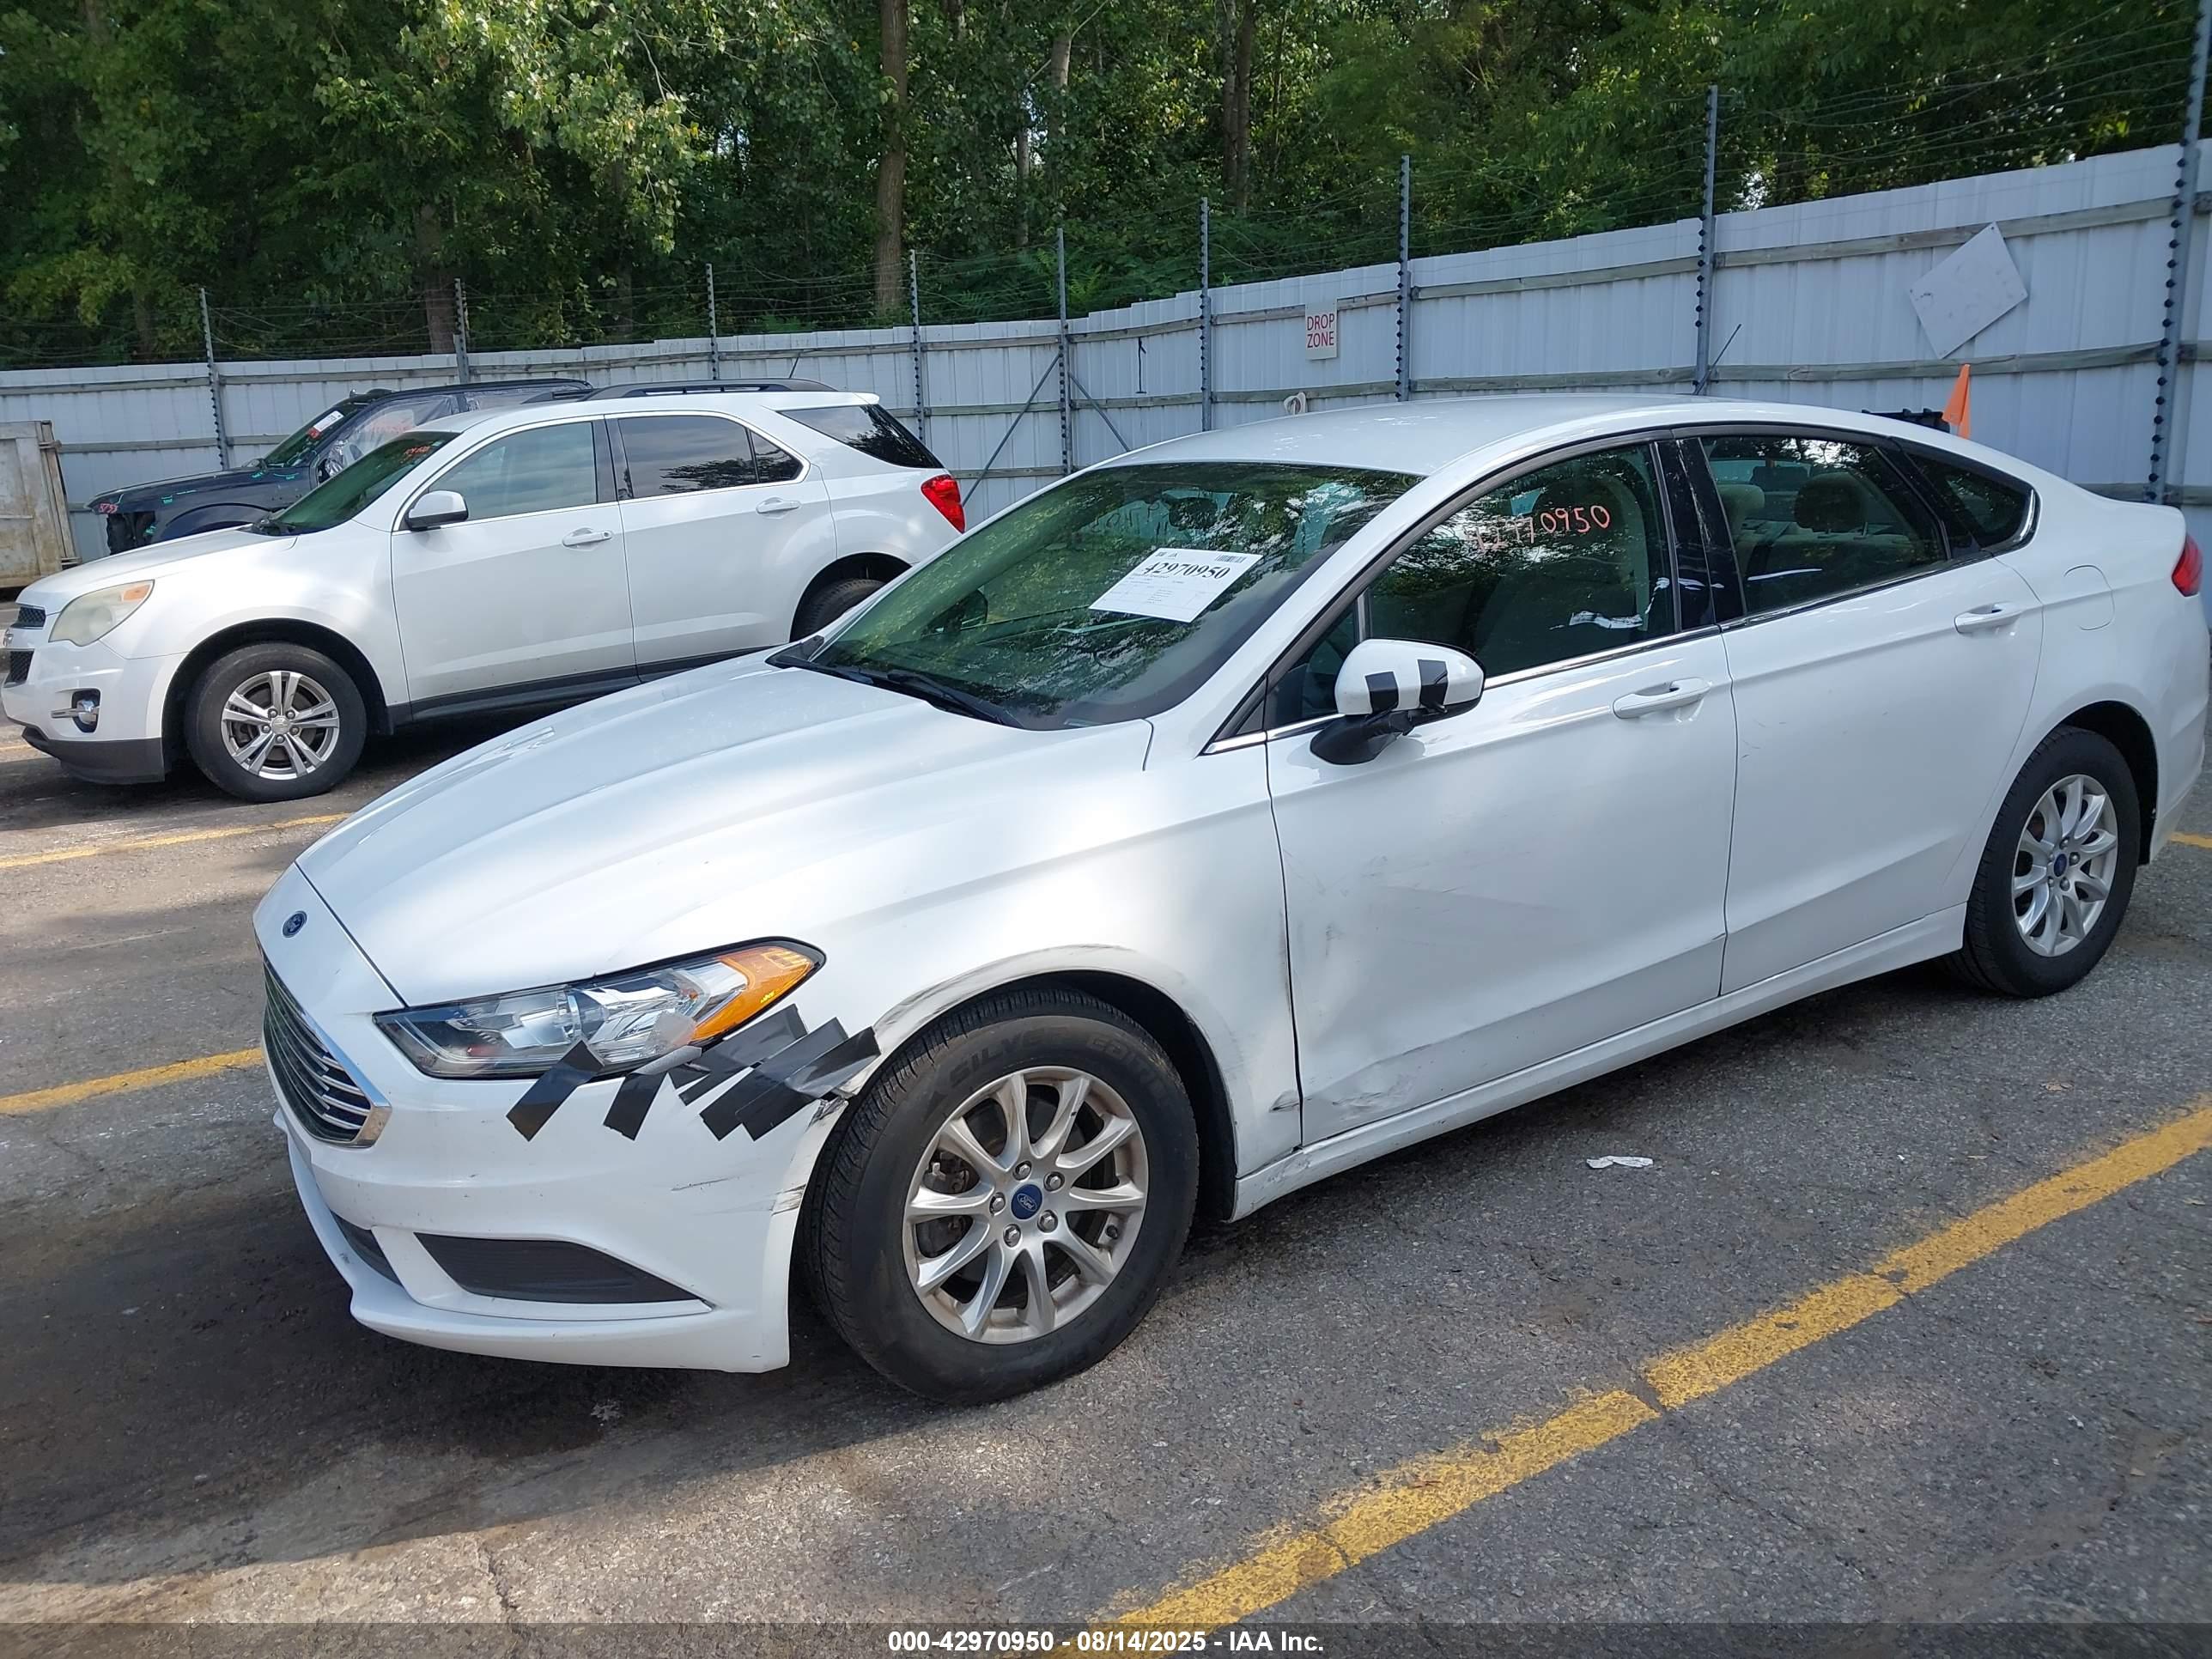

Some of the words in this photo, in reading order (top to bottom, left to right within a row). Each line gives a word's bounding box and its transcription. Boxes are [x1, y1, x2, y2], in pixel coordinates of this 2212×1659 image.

[1307, 313, 1334, 331] DROP
[1307, 331, 1334, 348] ZONE
[1141, 562, 1231, 580] 42970950
